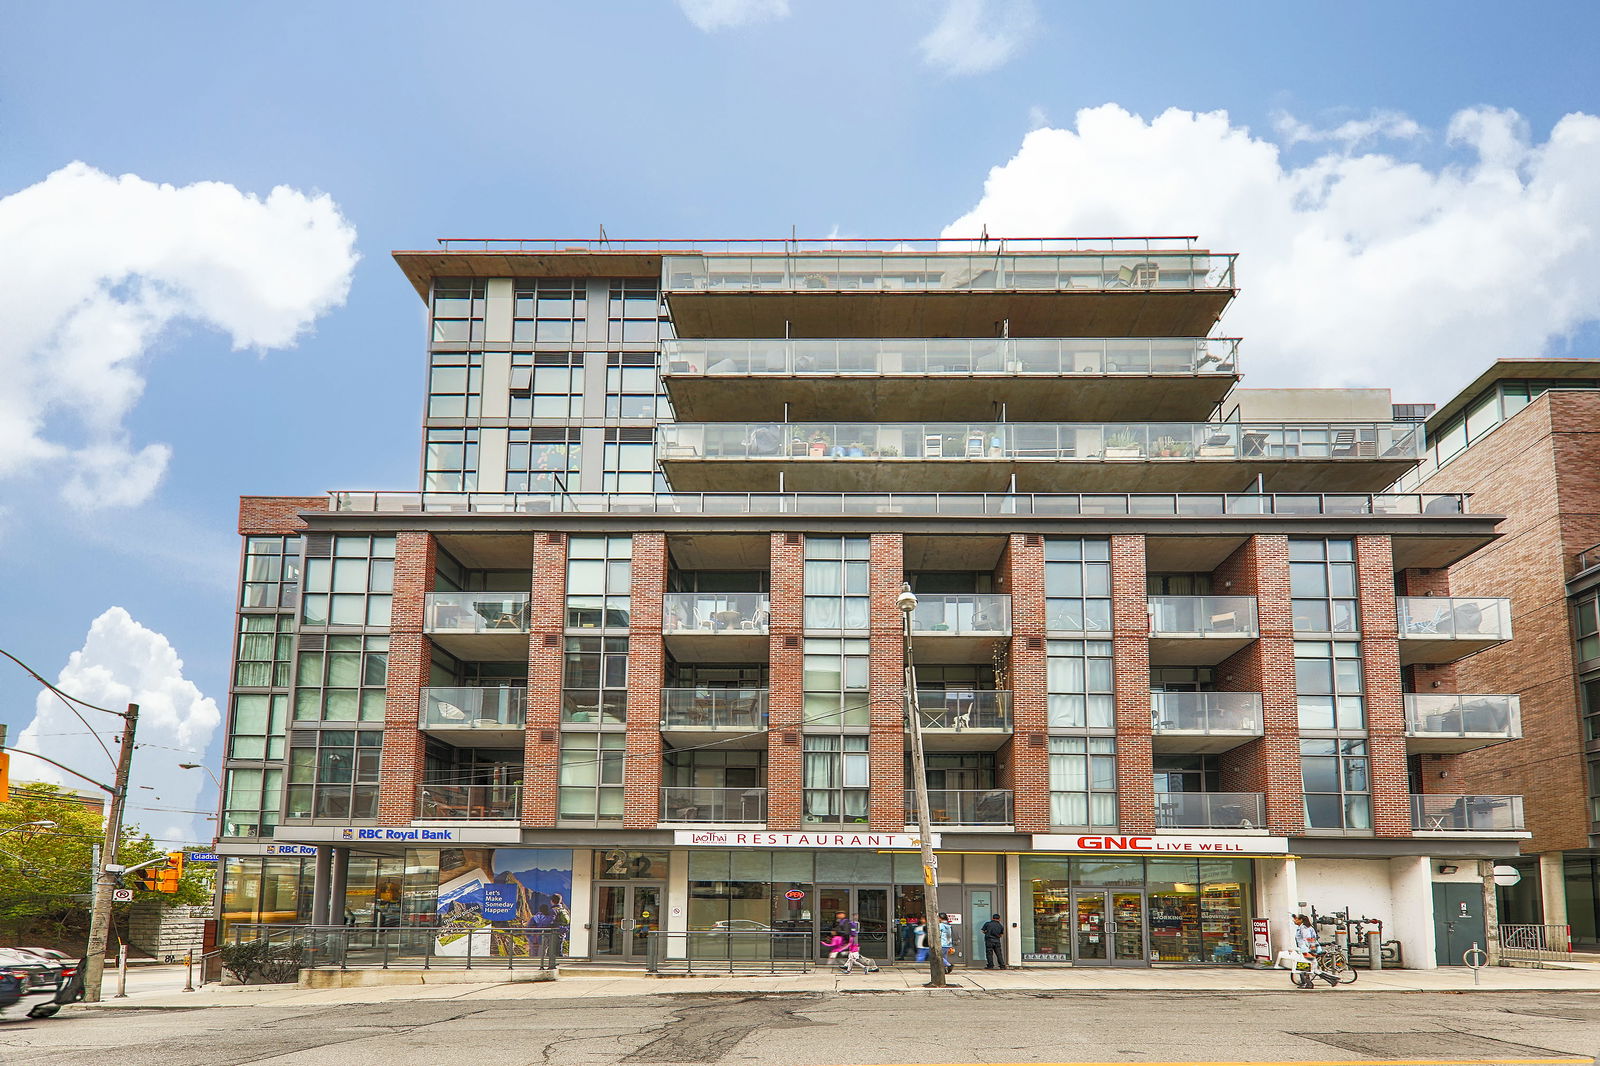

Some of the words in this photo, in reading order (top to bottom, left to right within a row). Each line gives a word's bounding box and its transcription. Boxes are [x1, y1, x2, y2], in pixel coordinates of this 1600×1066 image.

[358, 829, 383, 839] RBC
[386, 829, 418, 841] Royal
[422, 829, 452, 840] Bank
[737, 833, 896, 846] RESTAURANT
[1077, 836, 1153, 850] GNC
[1156, 843, 1192, 851] LIVE
[1199, 843, 1243, 851] WELL
[279, 845, 298, 854] RBC
[300, 845, 317, 856] Roy
[485, 901, 514, 909] Someday
